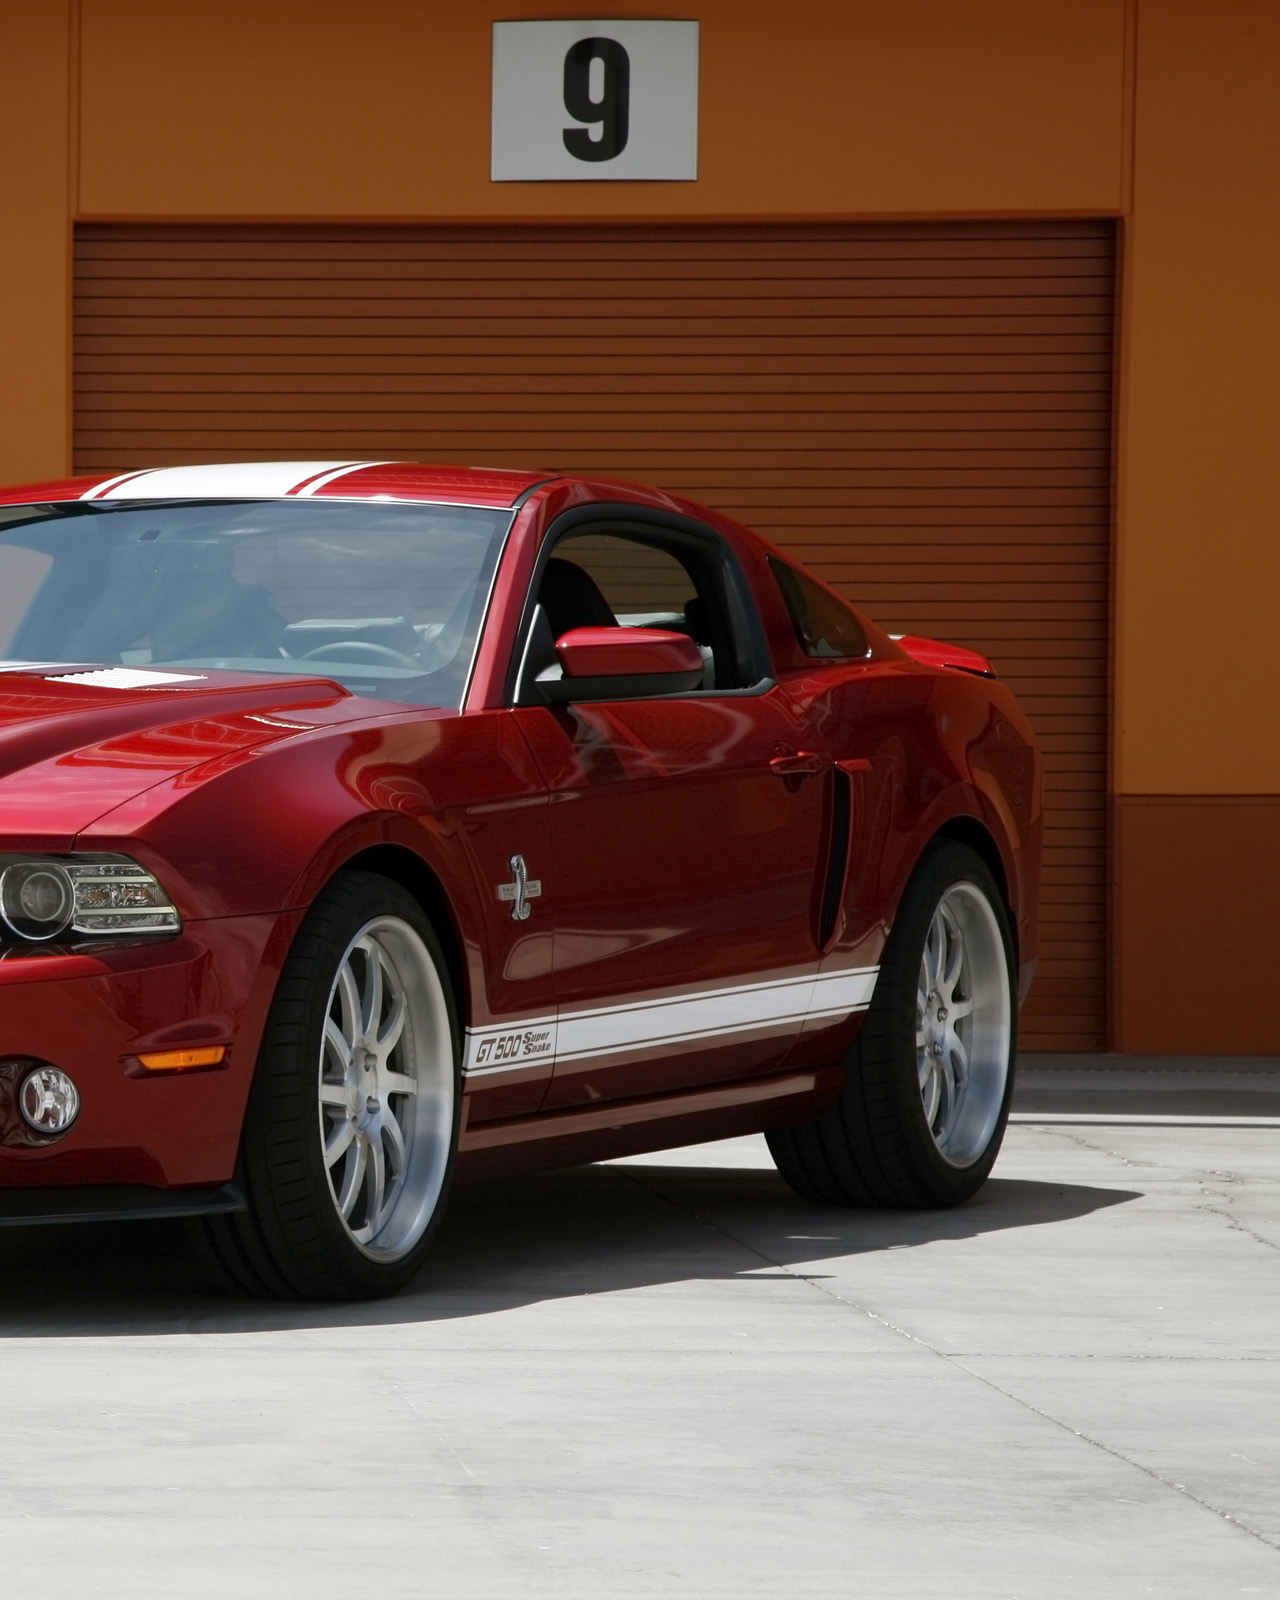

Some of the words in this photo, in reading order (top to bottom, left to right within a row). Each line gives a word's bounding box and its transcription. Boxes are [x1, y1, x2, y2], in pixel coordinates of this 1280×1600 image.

[563, 36, 631, 162] 9
[523, 1032, 549, 1044] Super
[523, 1043, 551, 1055] Snake
